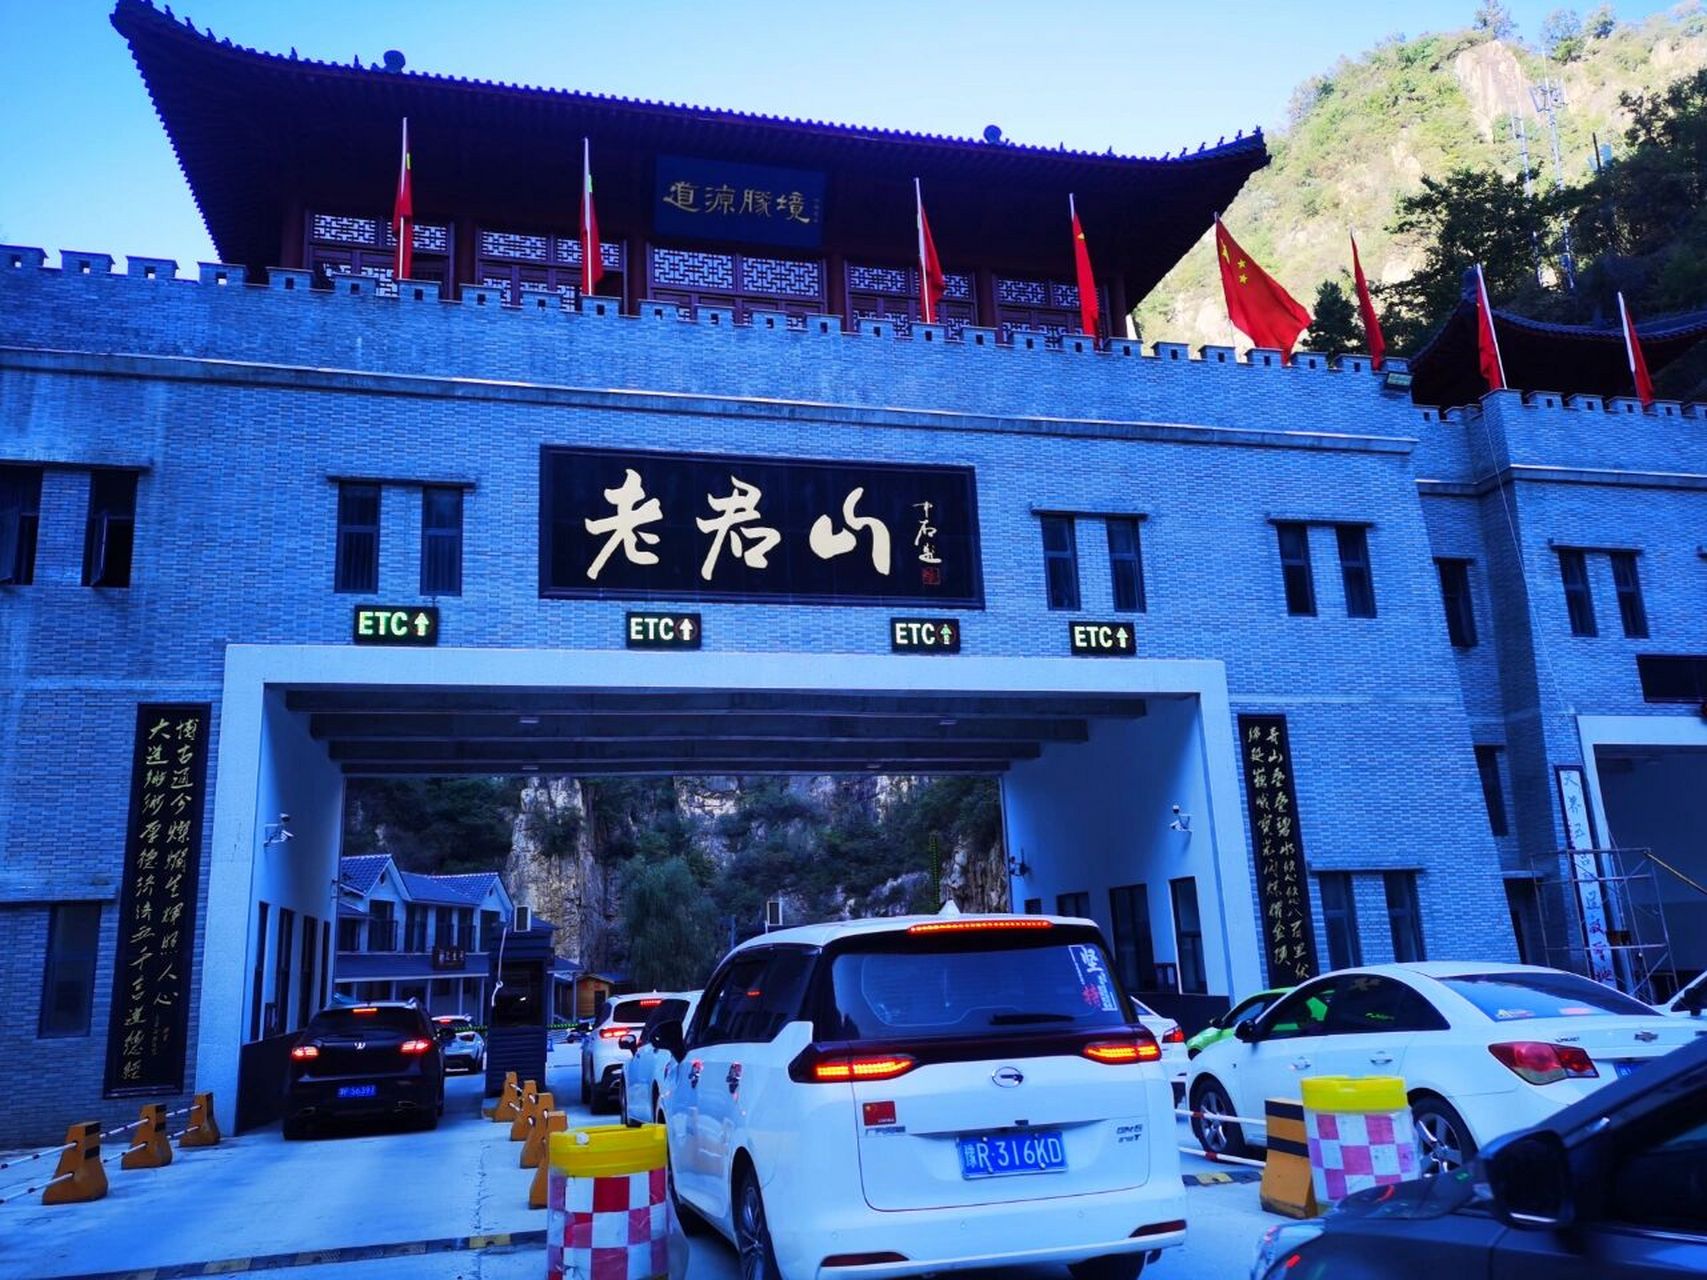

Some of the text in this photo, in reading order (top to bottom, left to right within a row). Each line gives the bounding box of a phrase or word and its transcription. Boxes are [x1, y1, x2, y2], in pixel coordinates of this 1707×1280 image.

[585, 469, 890, 581] 老君山
[358, 611, 408, 636] ETC
[630, 618, 674, 640] ETC
[895, 623, 936, 645] ETC
[1074, 626, 1113, 648] ETC
